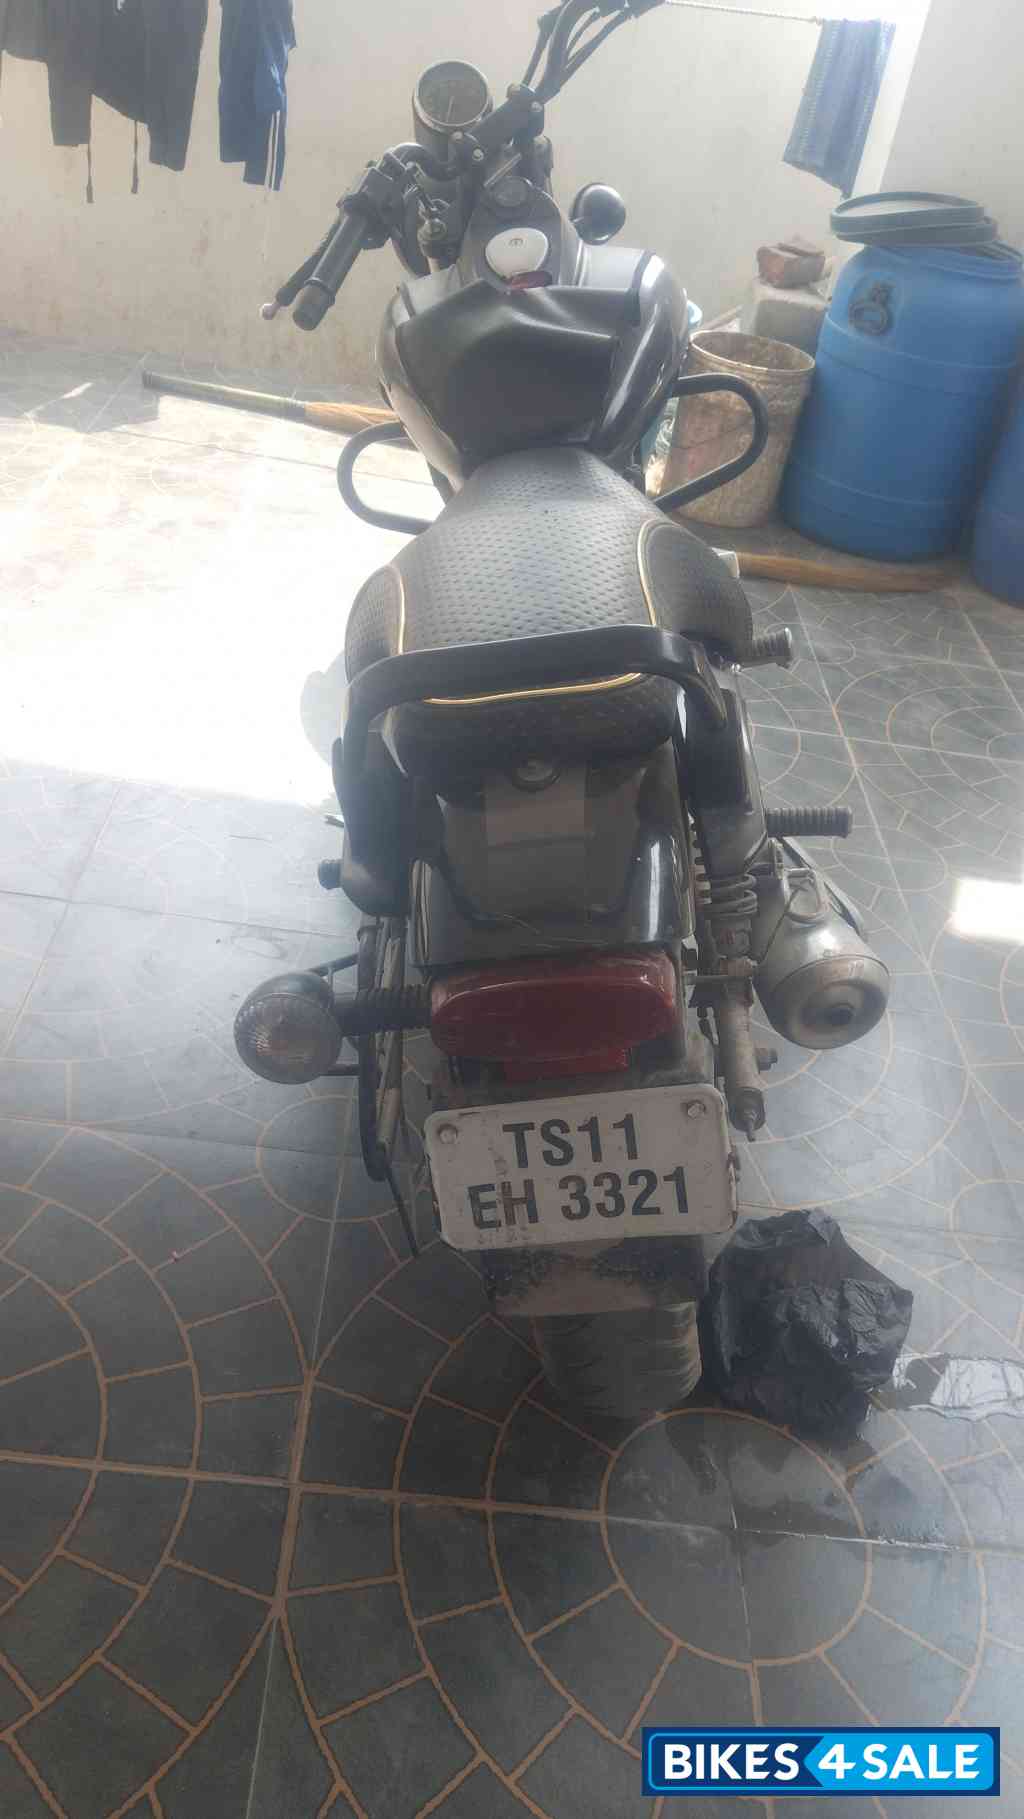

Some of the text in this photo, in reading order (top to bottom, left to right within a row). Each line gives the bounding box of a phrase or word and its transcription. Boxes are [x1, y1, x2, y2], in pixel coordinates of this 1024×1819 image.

[502, 1113, 638, 1169] TS11
[467, 1166, 689, 1229] EH 3321
